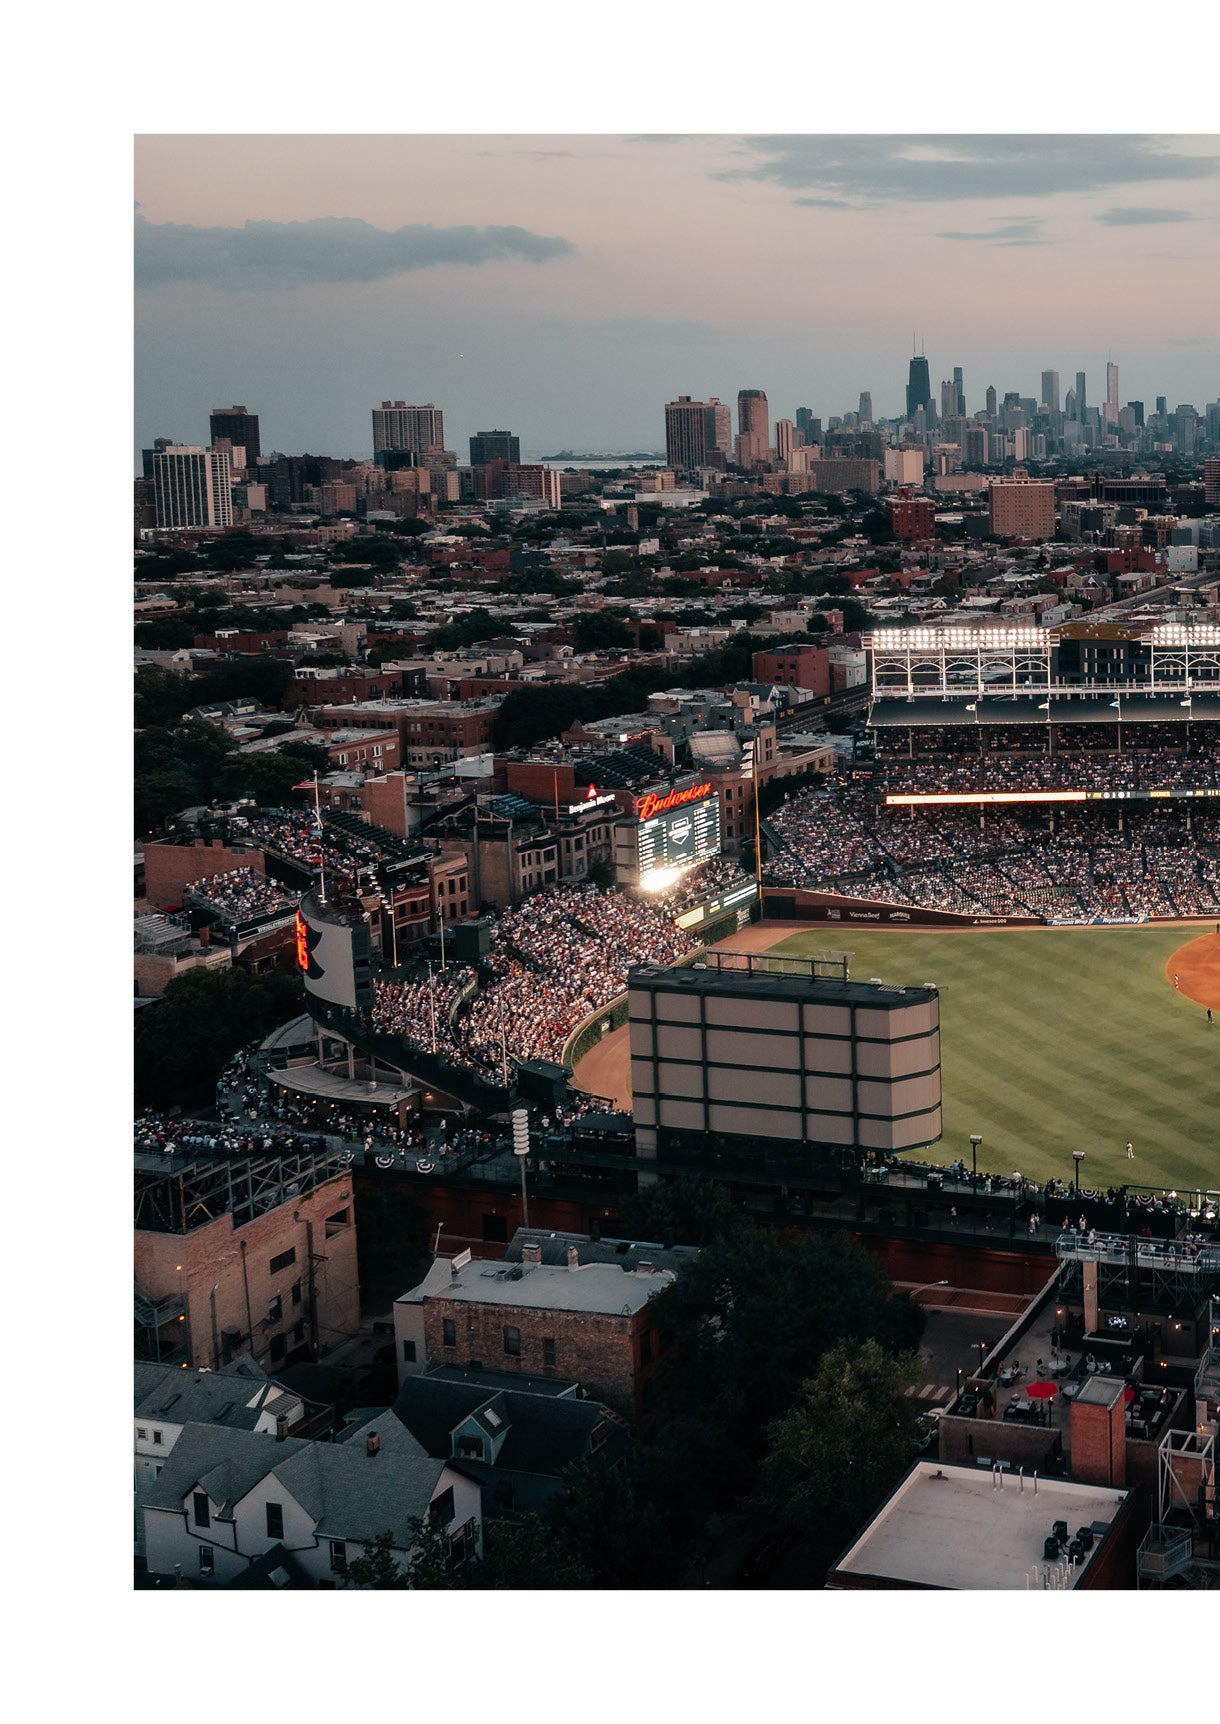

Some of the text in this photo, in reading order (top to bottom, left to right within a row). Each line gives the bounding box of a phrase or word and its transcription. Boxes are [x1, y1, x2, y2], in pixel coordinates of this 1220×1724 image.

[568, 794, 616, 815] Benjamin Moore
[636, 782, 712, 819] Budweiser
